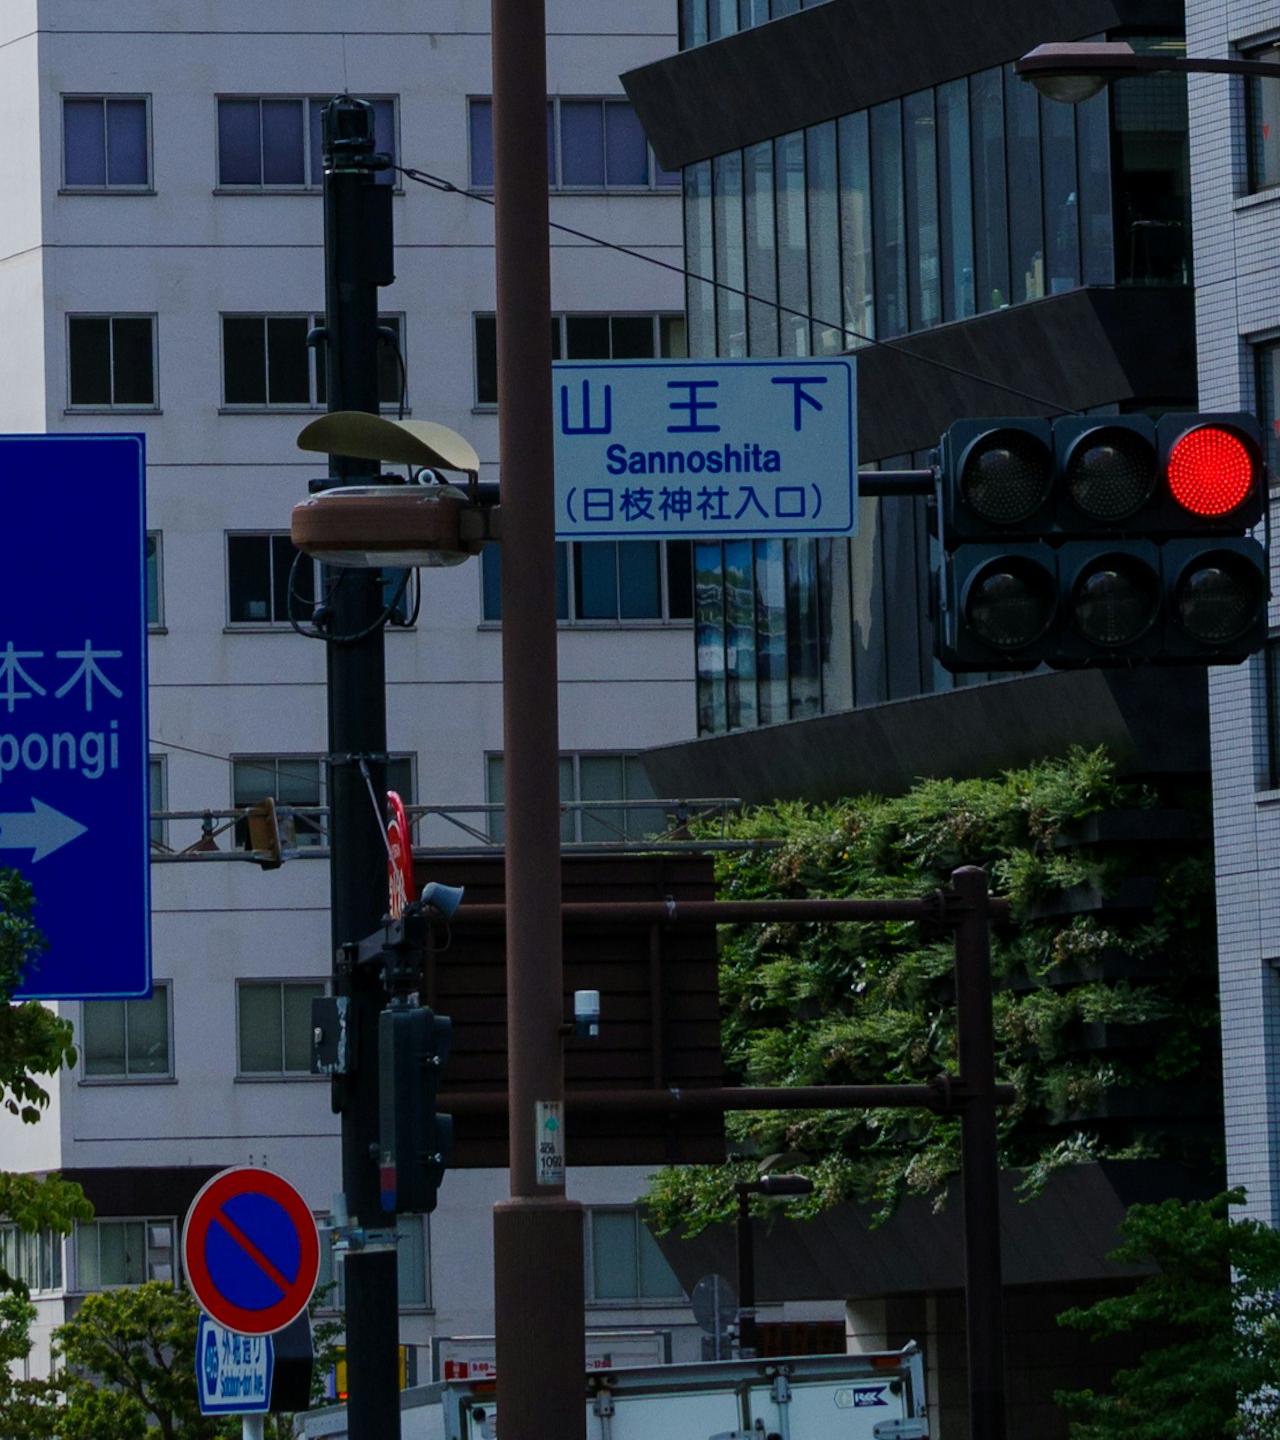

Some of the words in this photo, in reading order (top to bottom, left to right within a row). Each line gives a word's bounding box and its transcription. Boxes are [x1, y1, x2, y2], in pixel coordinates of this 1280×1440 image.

[560, 376, 827, 435] 山王下
[606, 443, 781, 475] Sannoshita
[566, 482, 822, 523] （日枝神社入口）
